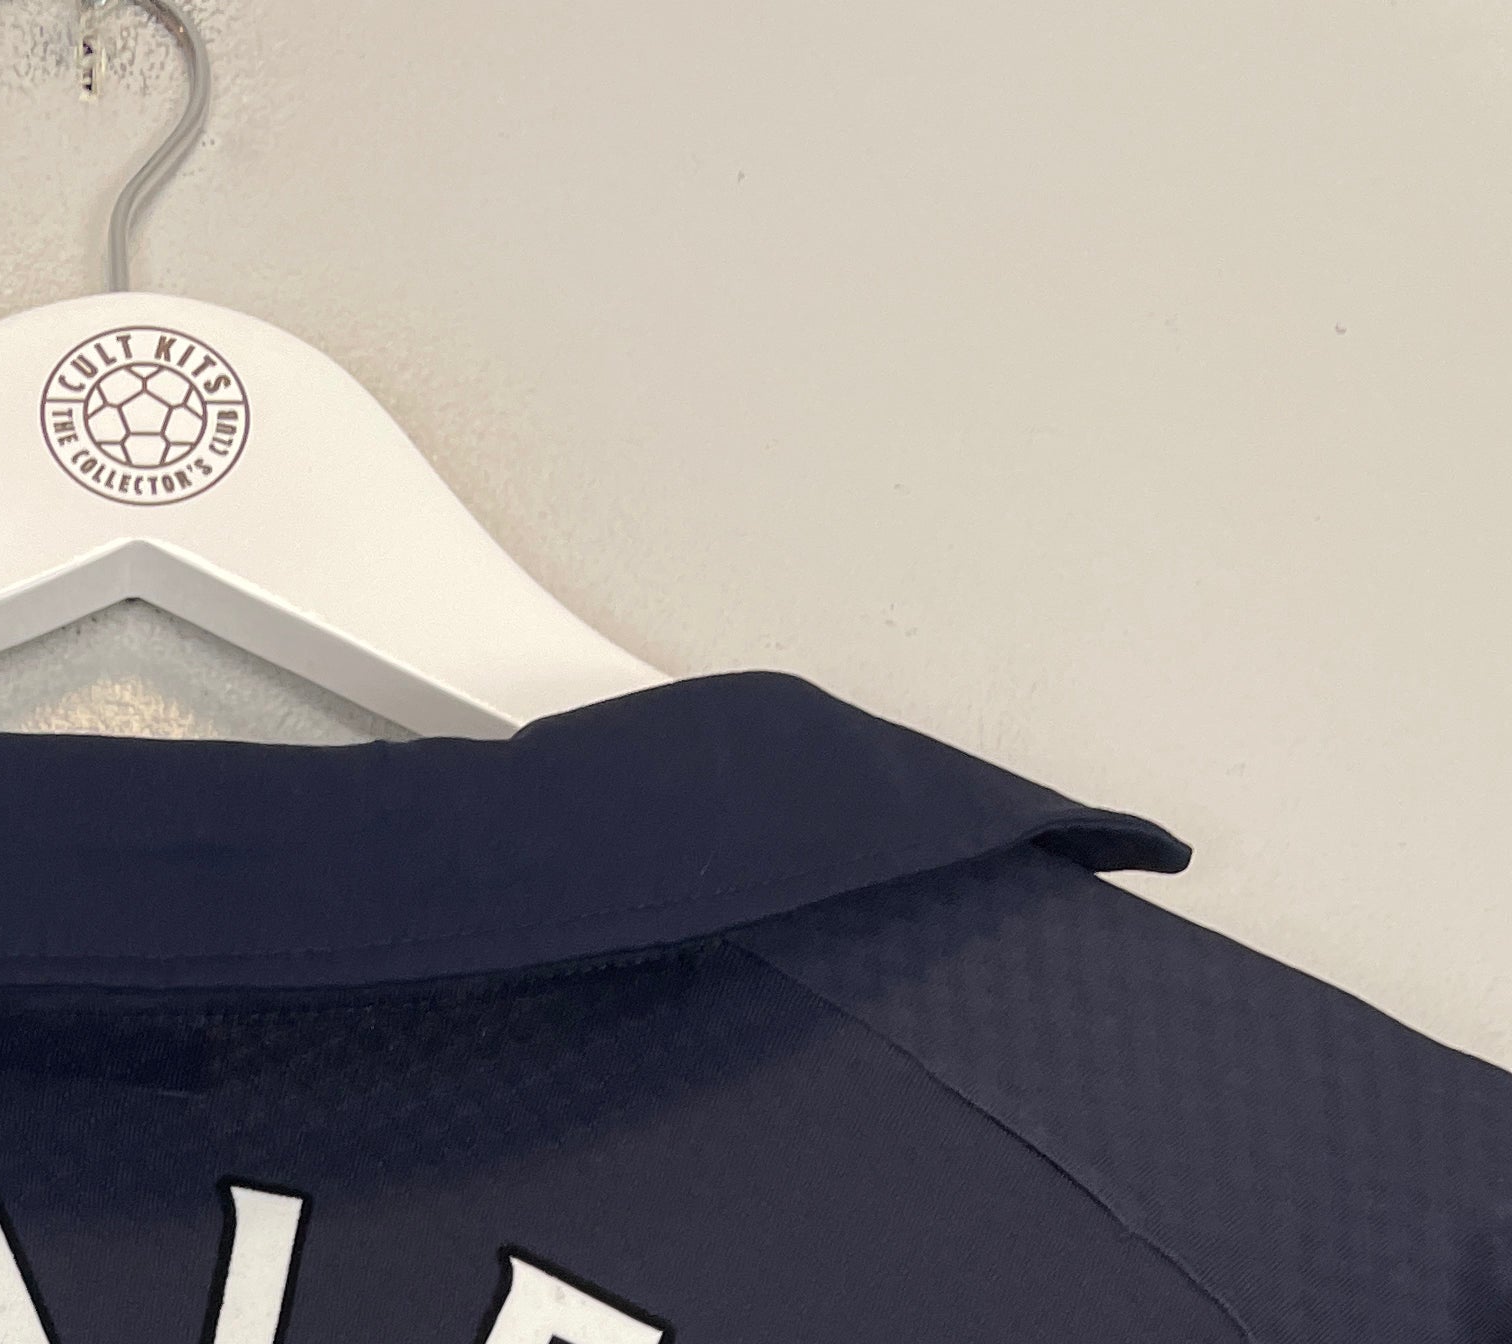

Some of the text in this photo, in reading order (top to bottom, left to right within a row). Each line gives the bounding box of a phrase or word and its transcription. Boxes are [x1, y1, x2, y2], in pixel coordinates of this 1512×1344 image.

[58, 334, 232, 394] CULT KITS
[51, 408, 239, 495] THE COLLECTOR'S CLUB
